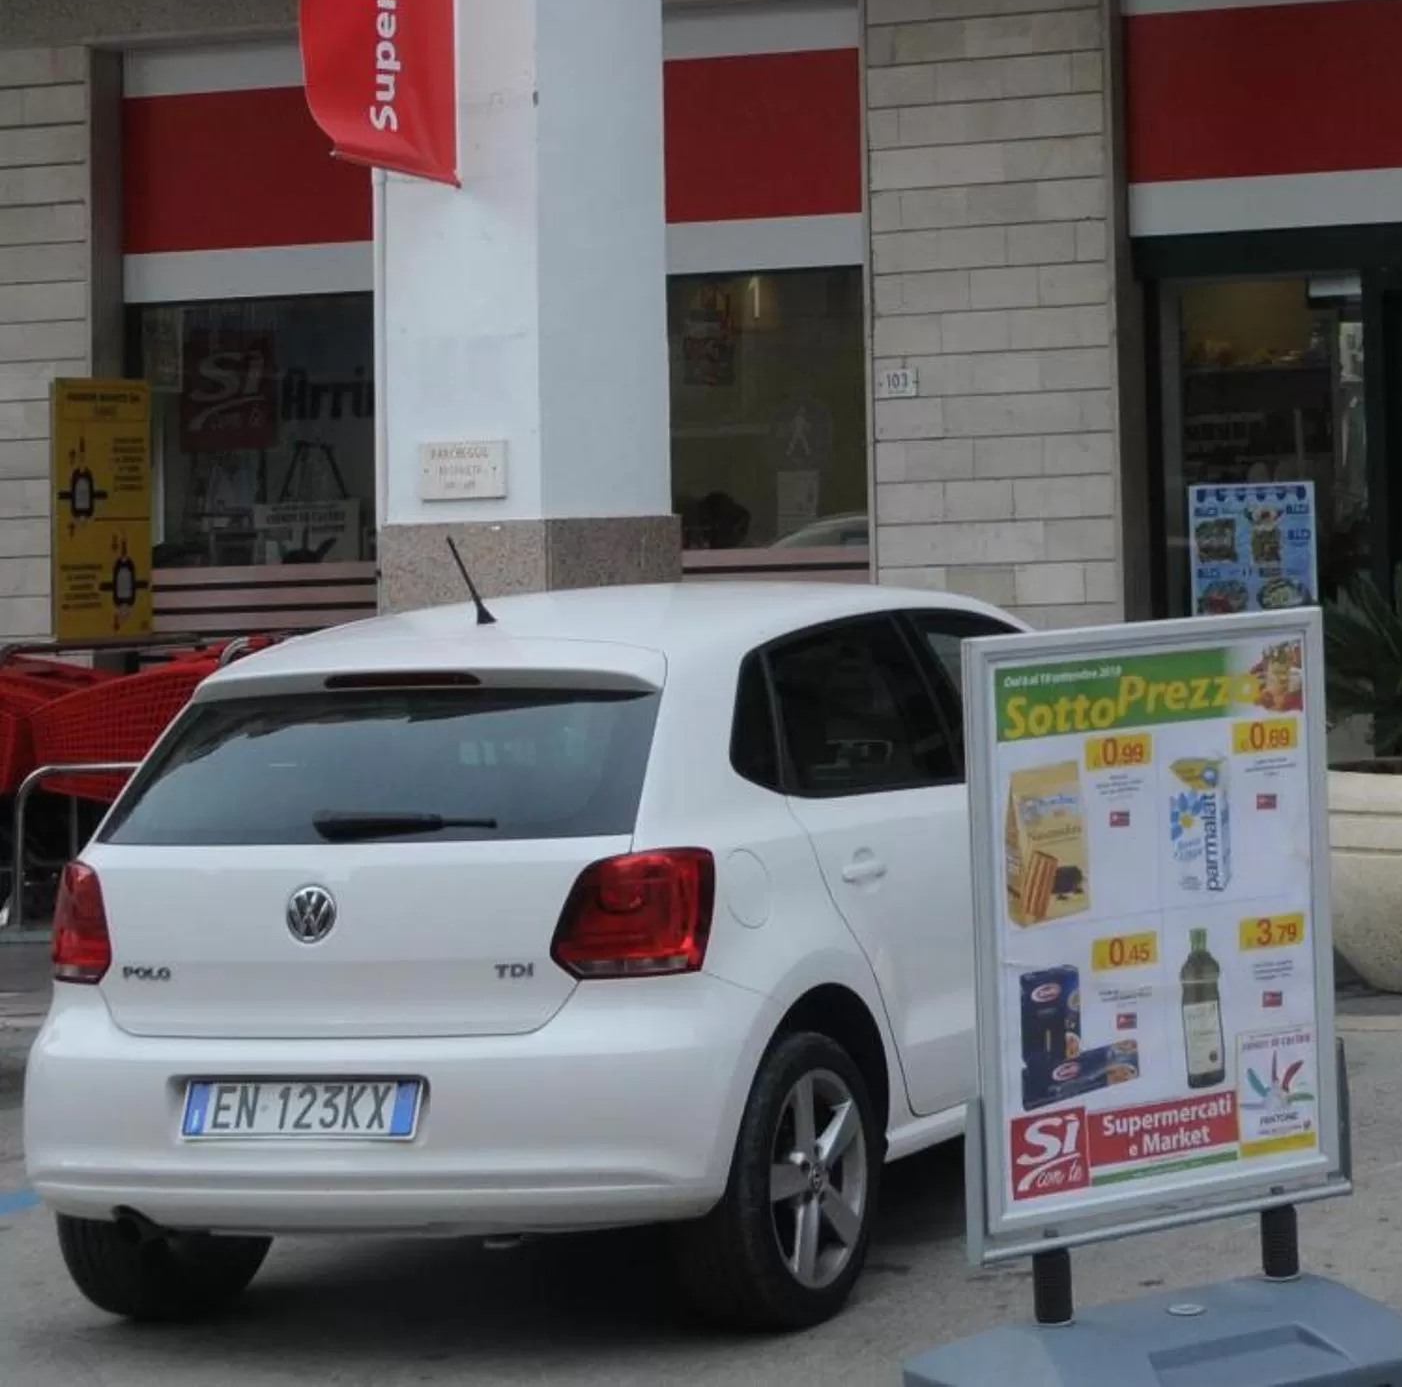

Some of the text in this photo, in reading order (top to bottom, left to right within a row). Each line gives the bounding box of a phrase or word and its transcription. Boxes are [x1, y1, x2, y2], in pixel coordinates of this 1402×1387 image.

[1200, 792, 1225, 893] parmalat
[122, 965, 172, 982] POLO
[493, 962, 534, 980] TDI
[211, 1083, 394, 1131] EN 123KX
[1102, 1093, 1232, 1138] Supermercati
[1128, 1124, 1211, 1158] e Market
